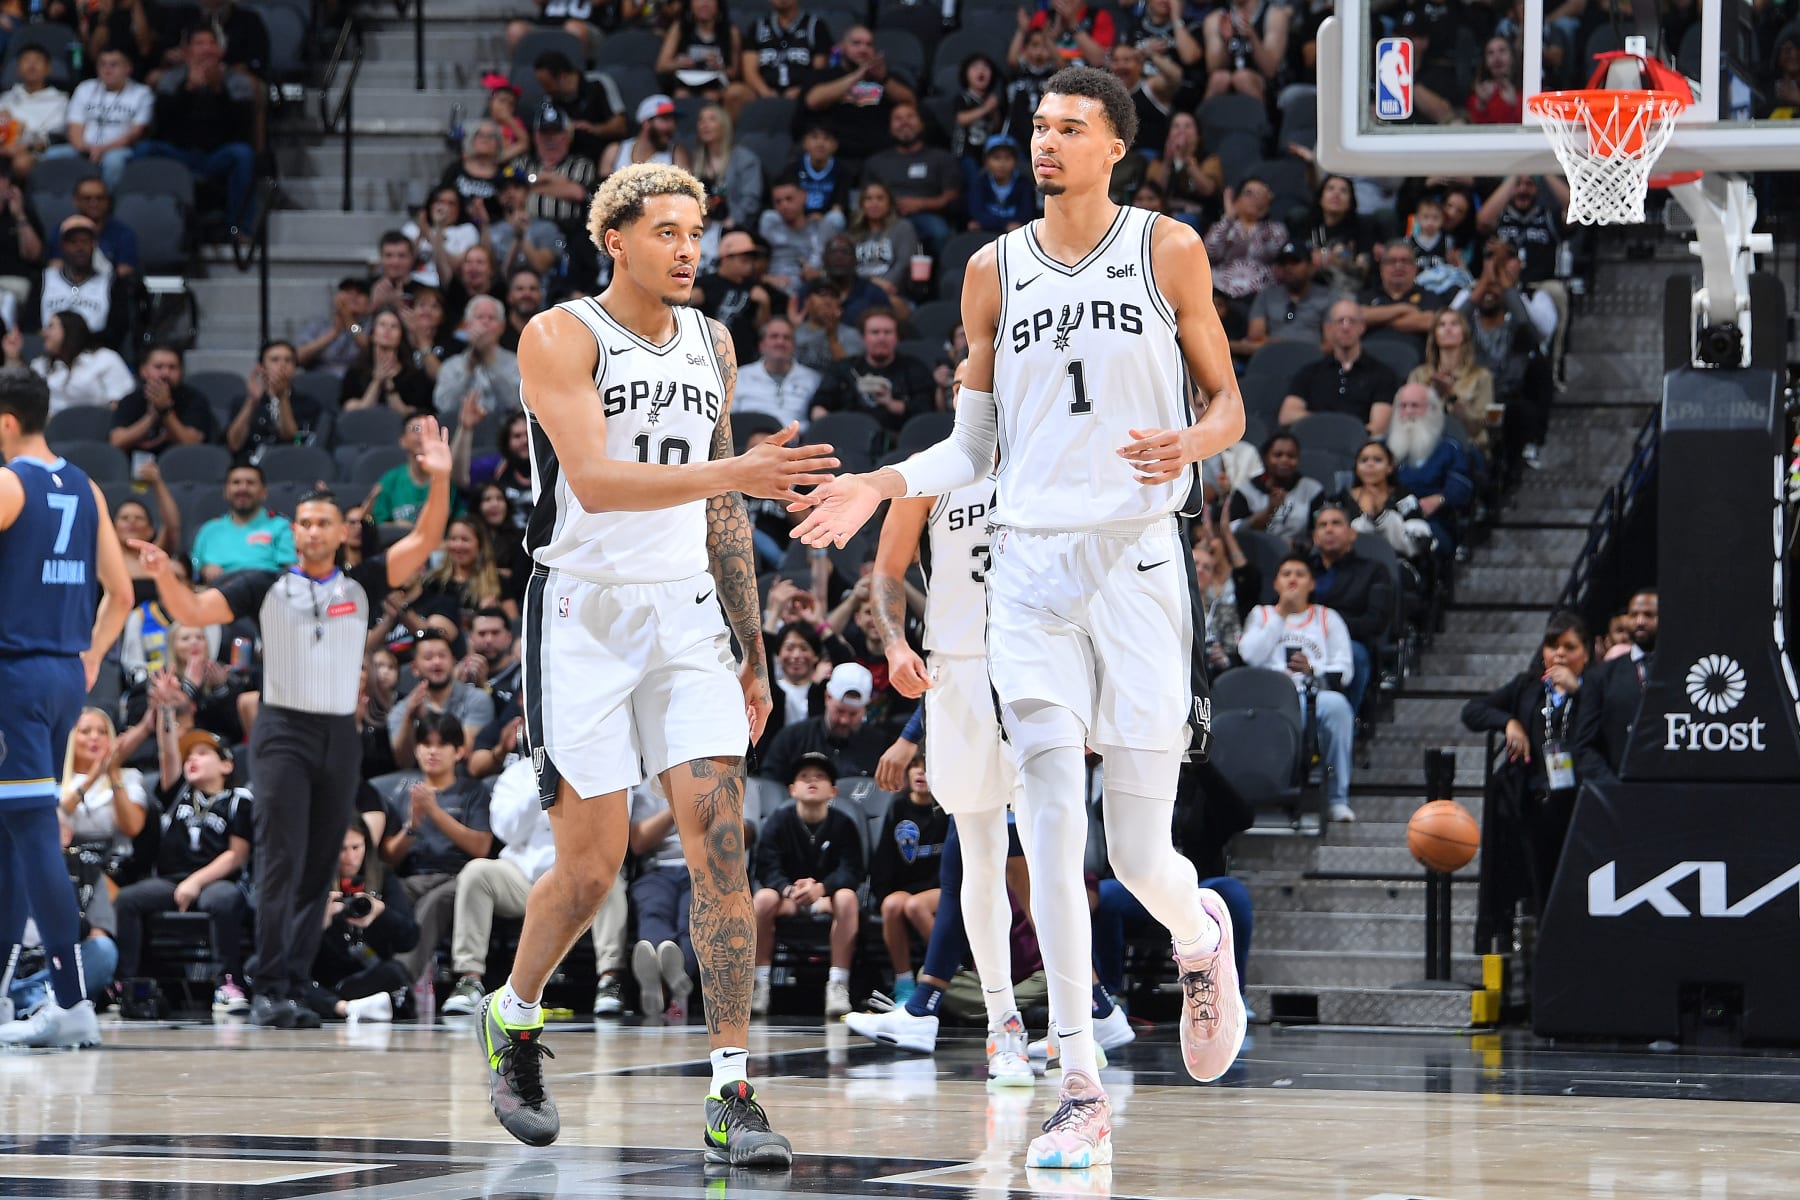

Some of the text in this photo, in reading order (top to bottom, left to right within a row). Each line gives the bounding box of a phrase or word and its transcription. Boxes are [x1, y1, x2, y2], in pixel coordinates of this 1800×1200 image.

[1106, 264, 1137, 279] Self.
[1012, 300, 1143, 353] SPURS
[686, 353, 709, 367] Self.
[604, 380, 719, 426] SPURS
[1065, 358, 1093, 416] 1
[632, 431, 692, 467] 10
[47, 492, 79, 554] 7
[1663, 712, 1766, 751] Frost
